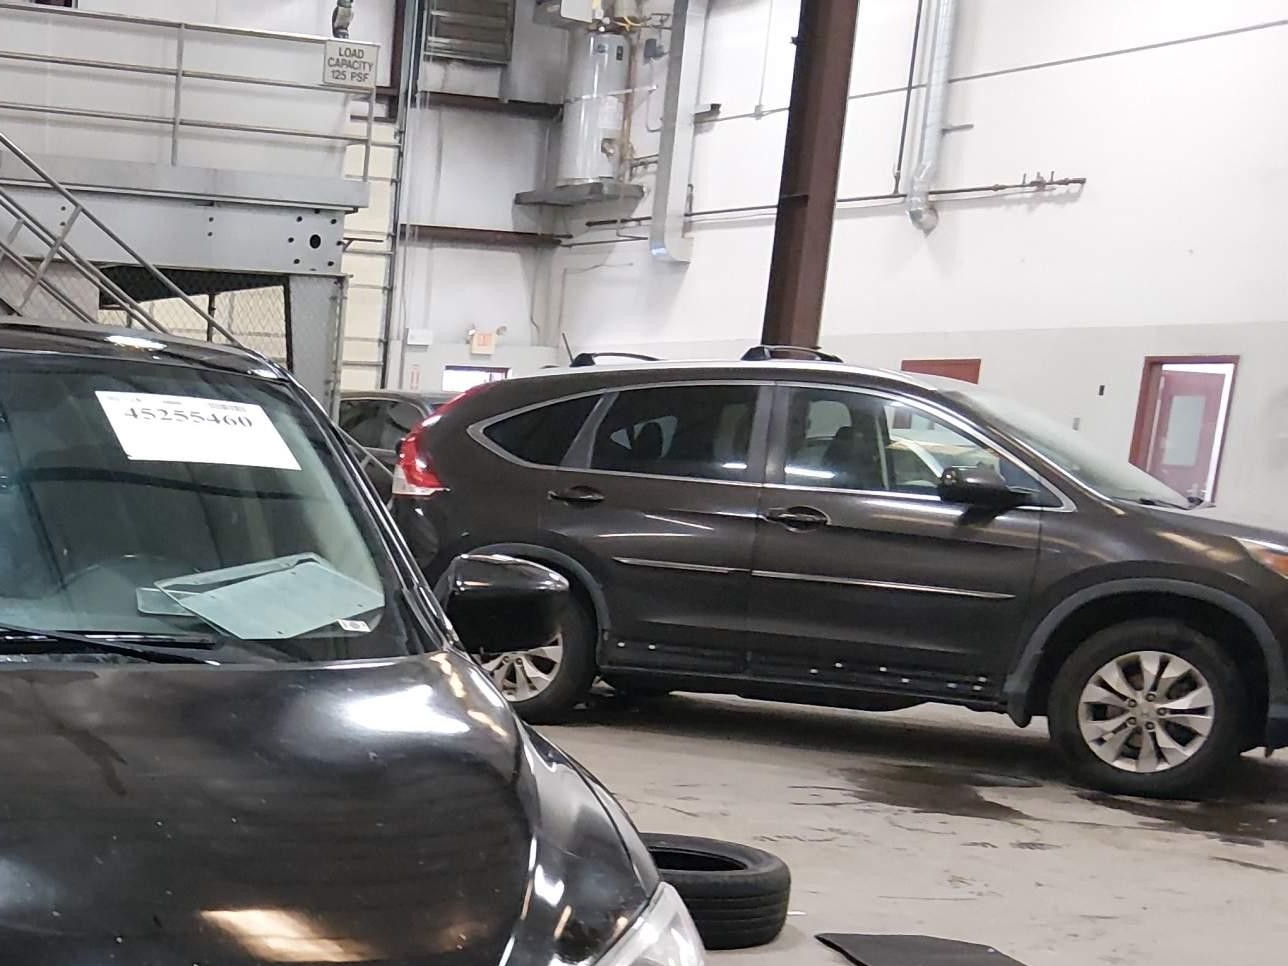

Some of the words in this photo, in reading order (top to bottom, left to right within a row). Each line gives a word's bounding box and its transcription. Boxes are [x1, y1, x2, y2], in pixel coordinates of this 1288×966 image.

[338, 47, 365, 59] LOAD
[327, 57, 374, 72] CAPACITY
[331, 70, 347, 81] 125
[350, 71, 370, 82] PSF
[124, 407, 253, 428] 45255460
